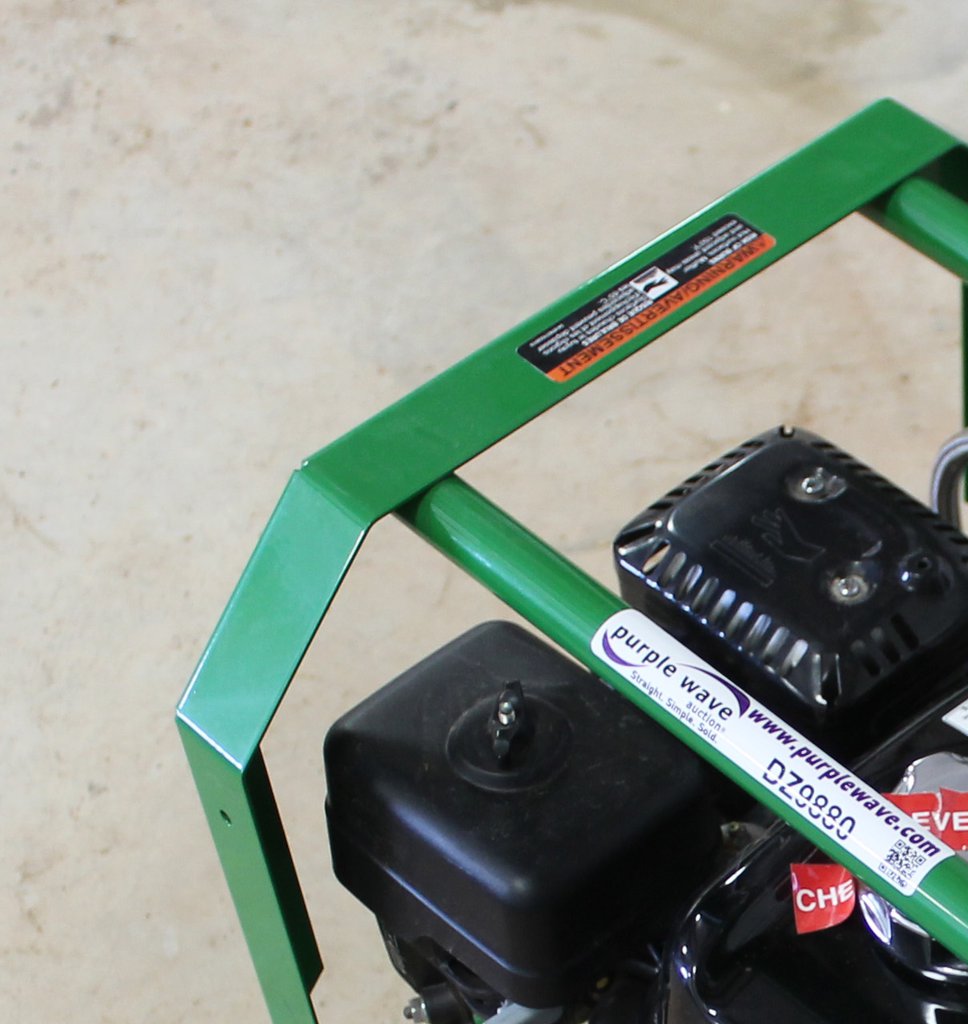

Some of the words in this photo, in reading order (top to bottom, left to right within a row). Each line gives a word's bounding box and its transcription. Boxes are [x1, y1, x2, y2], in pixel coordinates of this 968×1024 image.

[555, 244, 760, 376] WARNING/AVERTISSEMENT
[610, 624, 679, 678] purple
[678, 675, 735, 721] wave
[664, 698, 698, 727] Simple.
[696, 723, 720, 743] Sold.
[747, 708, 941, 858] www.purplewave.com
[758, 757, 861, 841] DZ9880
[796, 879, 854, 912] CHE
